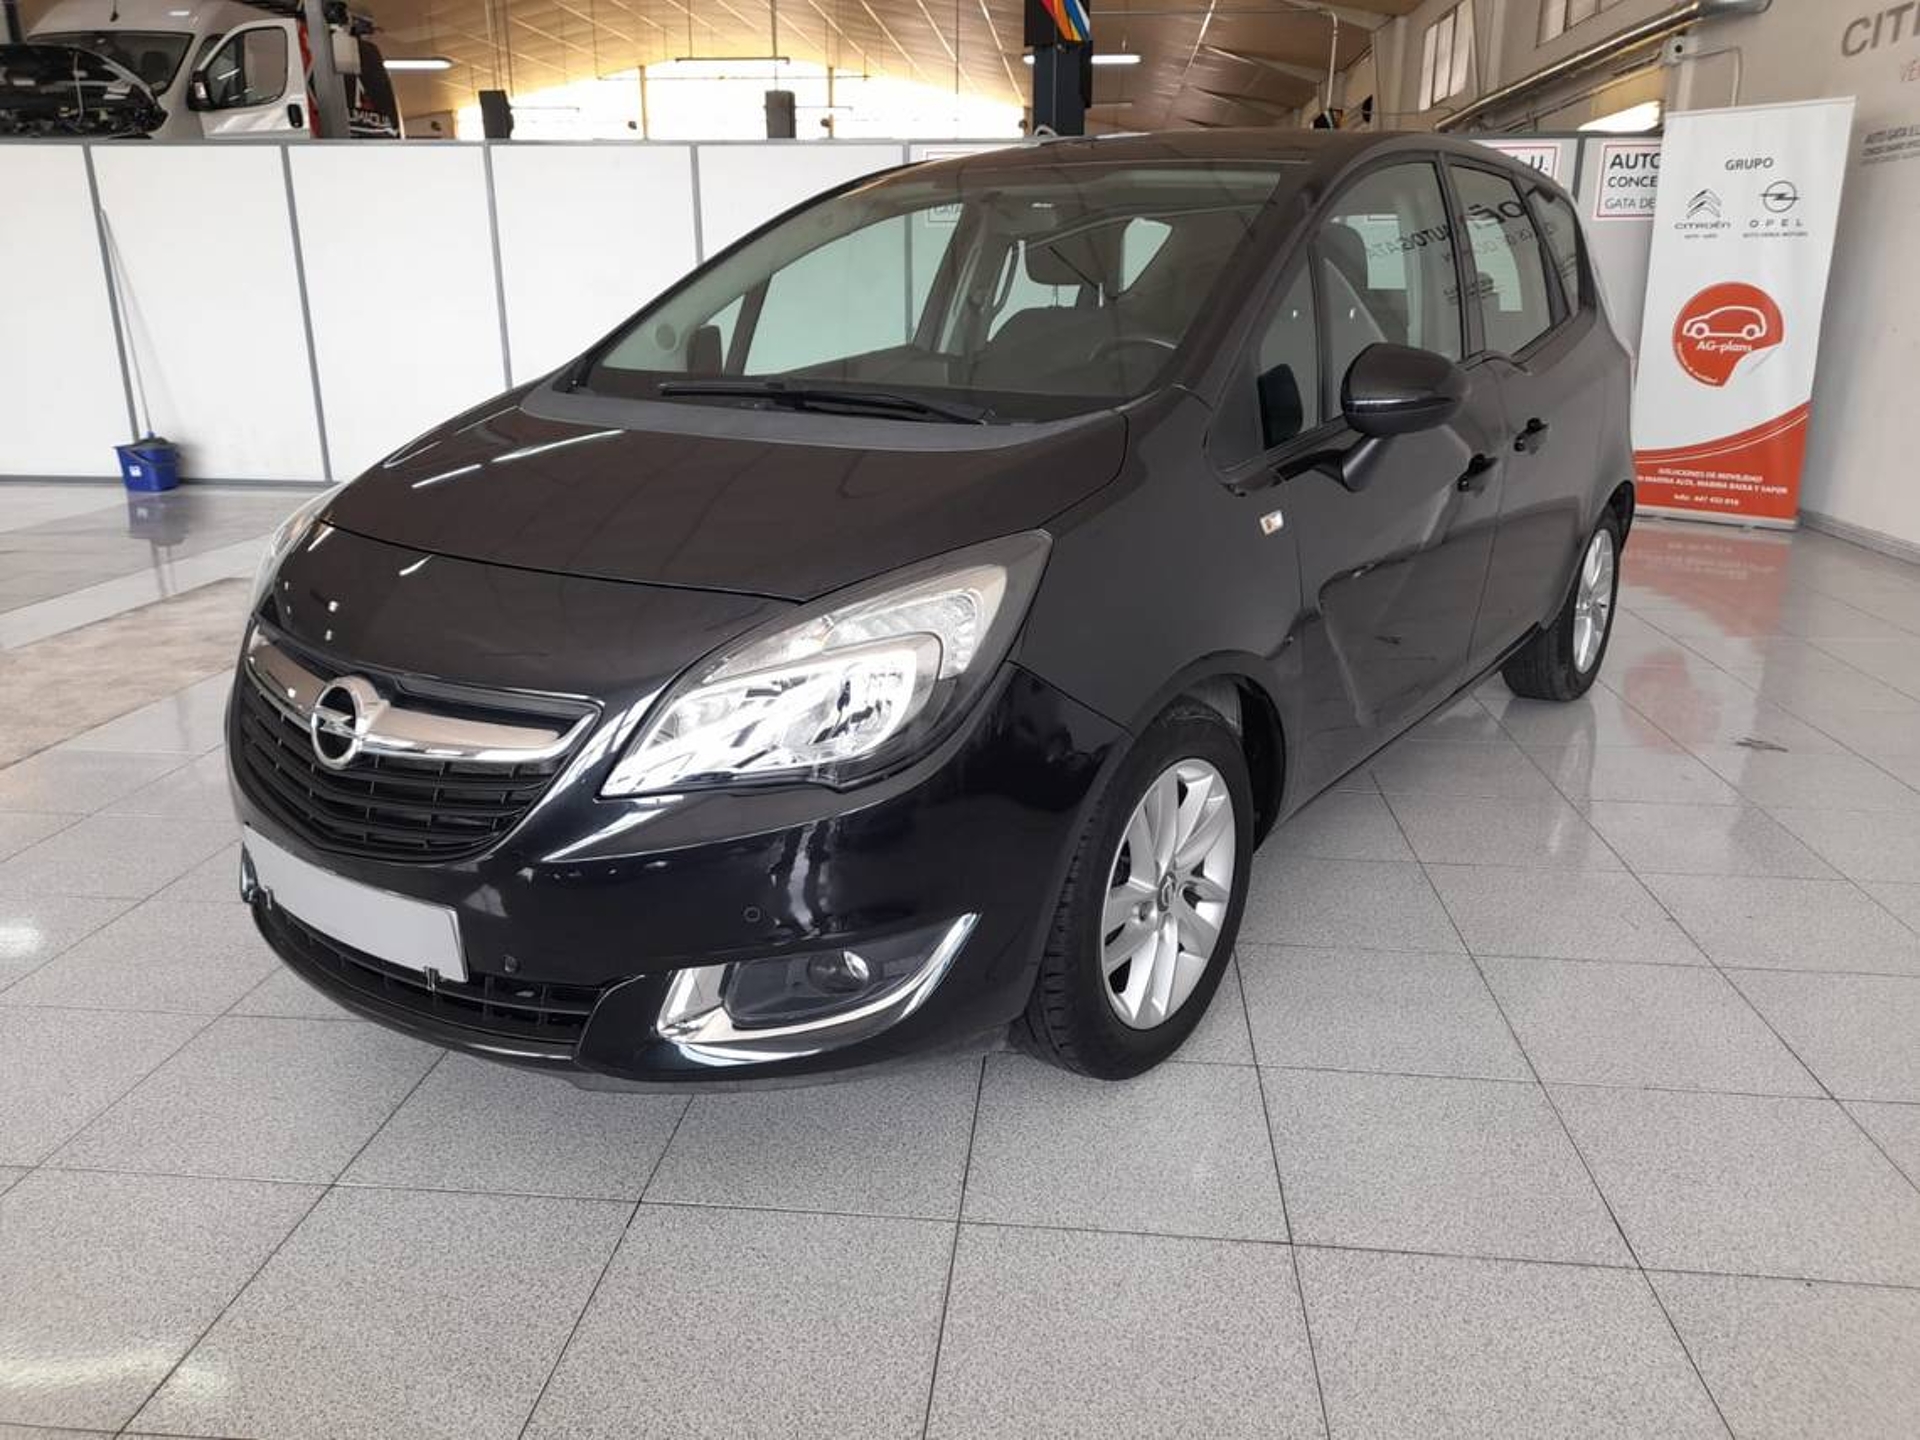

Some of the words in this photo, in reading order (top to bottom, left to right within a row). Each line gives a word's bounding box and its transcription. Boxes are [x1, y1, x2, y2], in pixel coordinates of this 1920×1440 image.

[1724, 157, 1775, 172] GRUPO
[1604, 198, 1637, 211] GATA
[1748, 218, 1803, 228] OPEL
